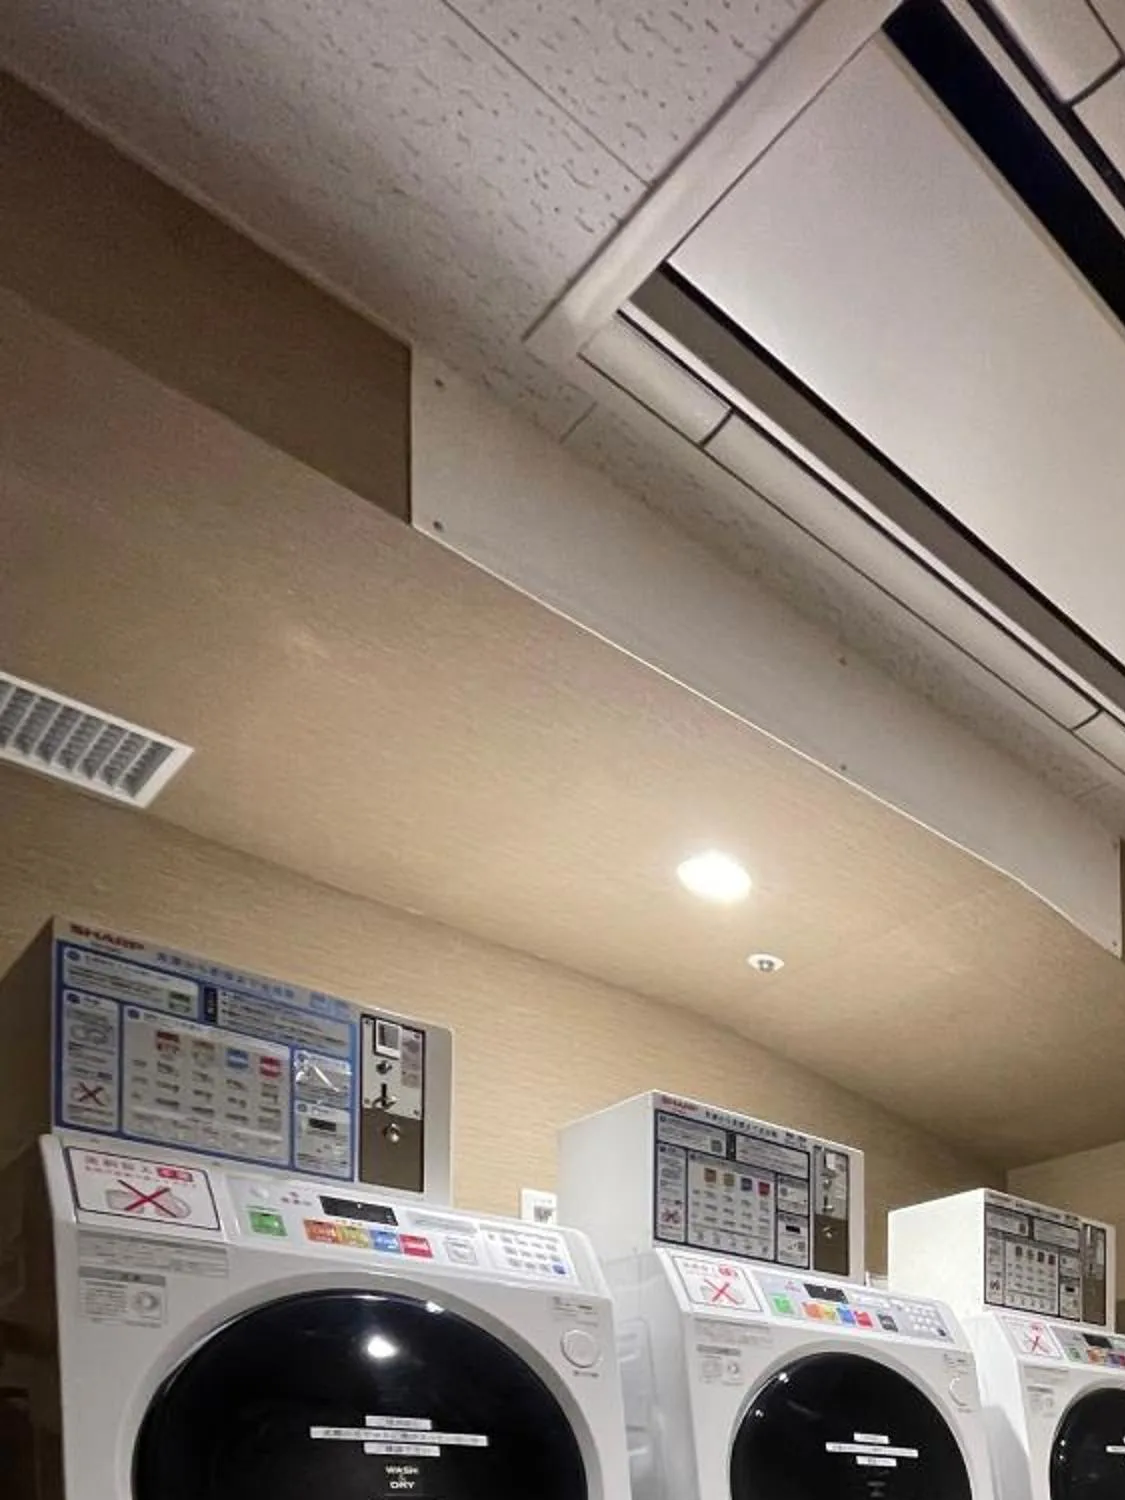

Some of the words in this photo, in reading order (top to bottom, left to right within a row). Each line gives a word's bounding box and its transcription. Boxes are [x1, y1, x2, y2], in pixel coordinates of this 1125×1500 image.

[70, 922, 145, 950] SHARP
[385, 1466, 419, 1475] WASH
[389, 1481, 415, 1489] DRY
